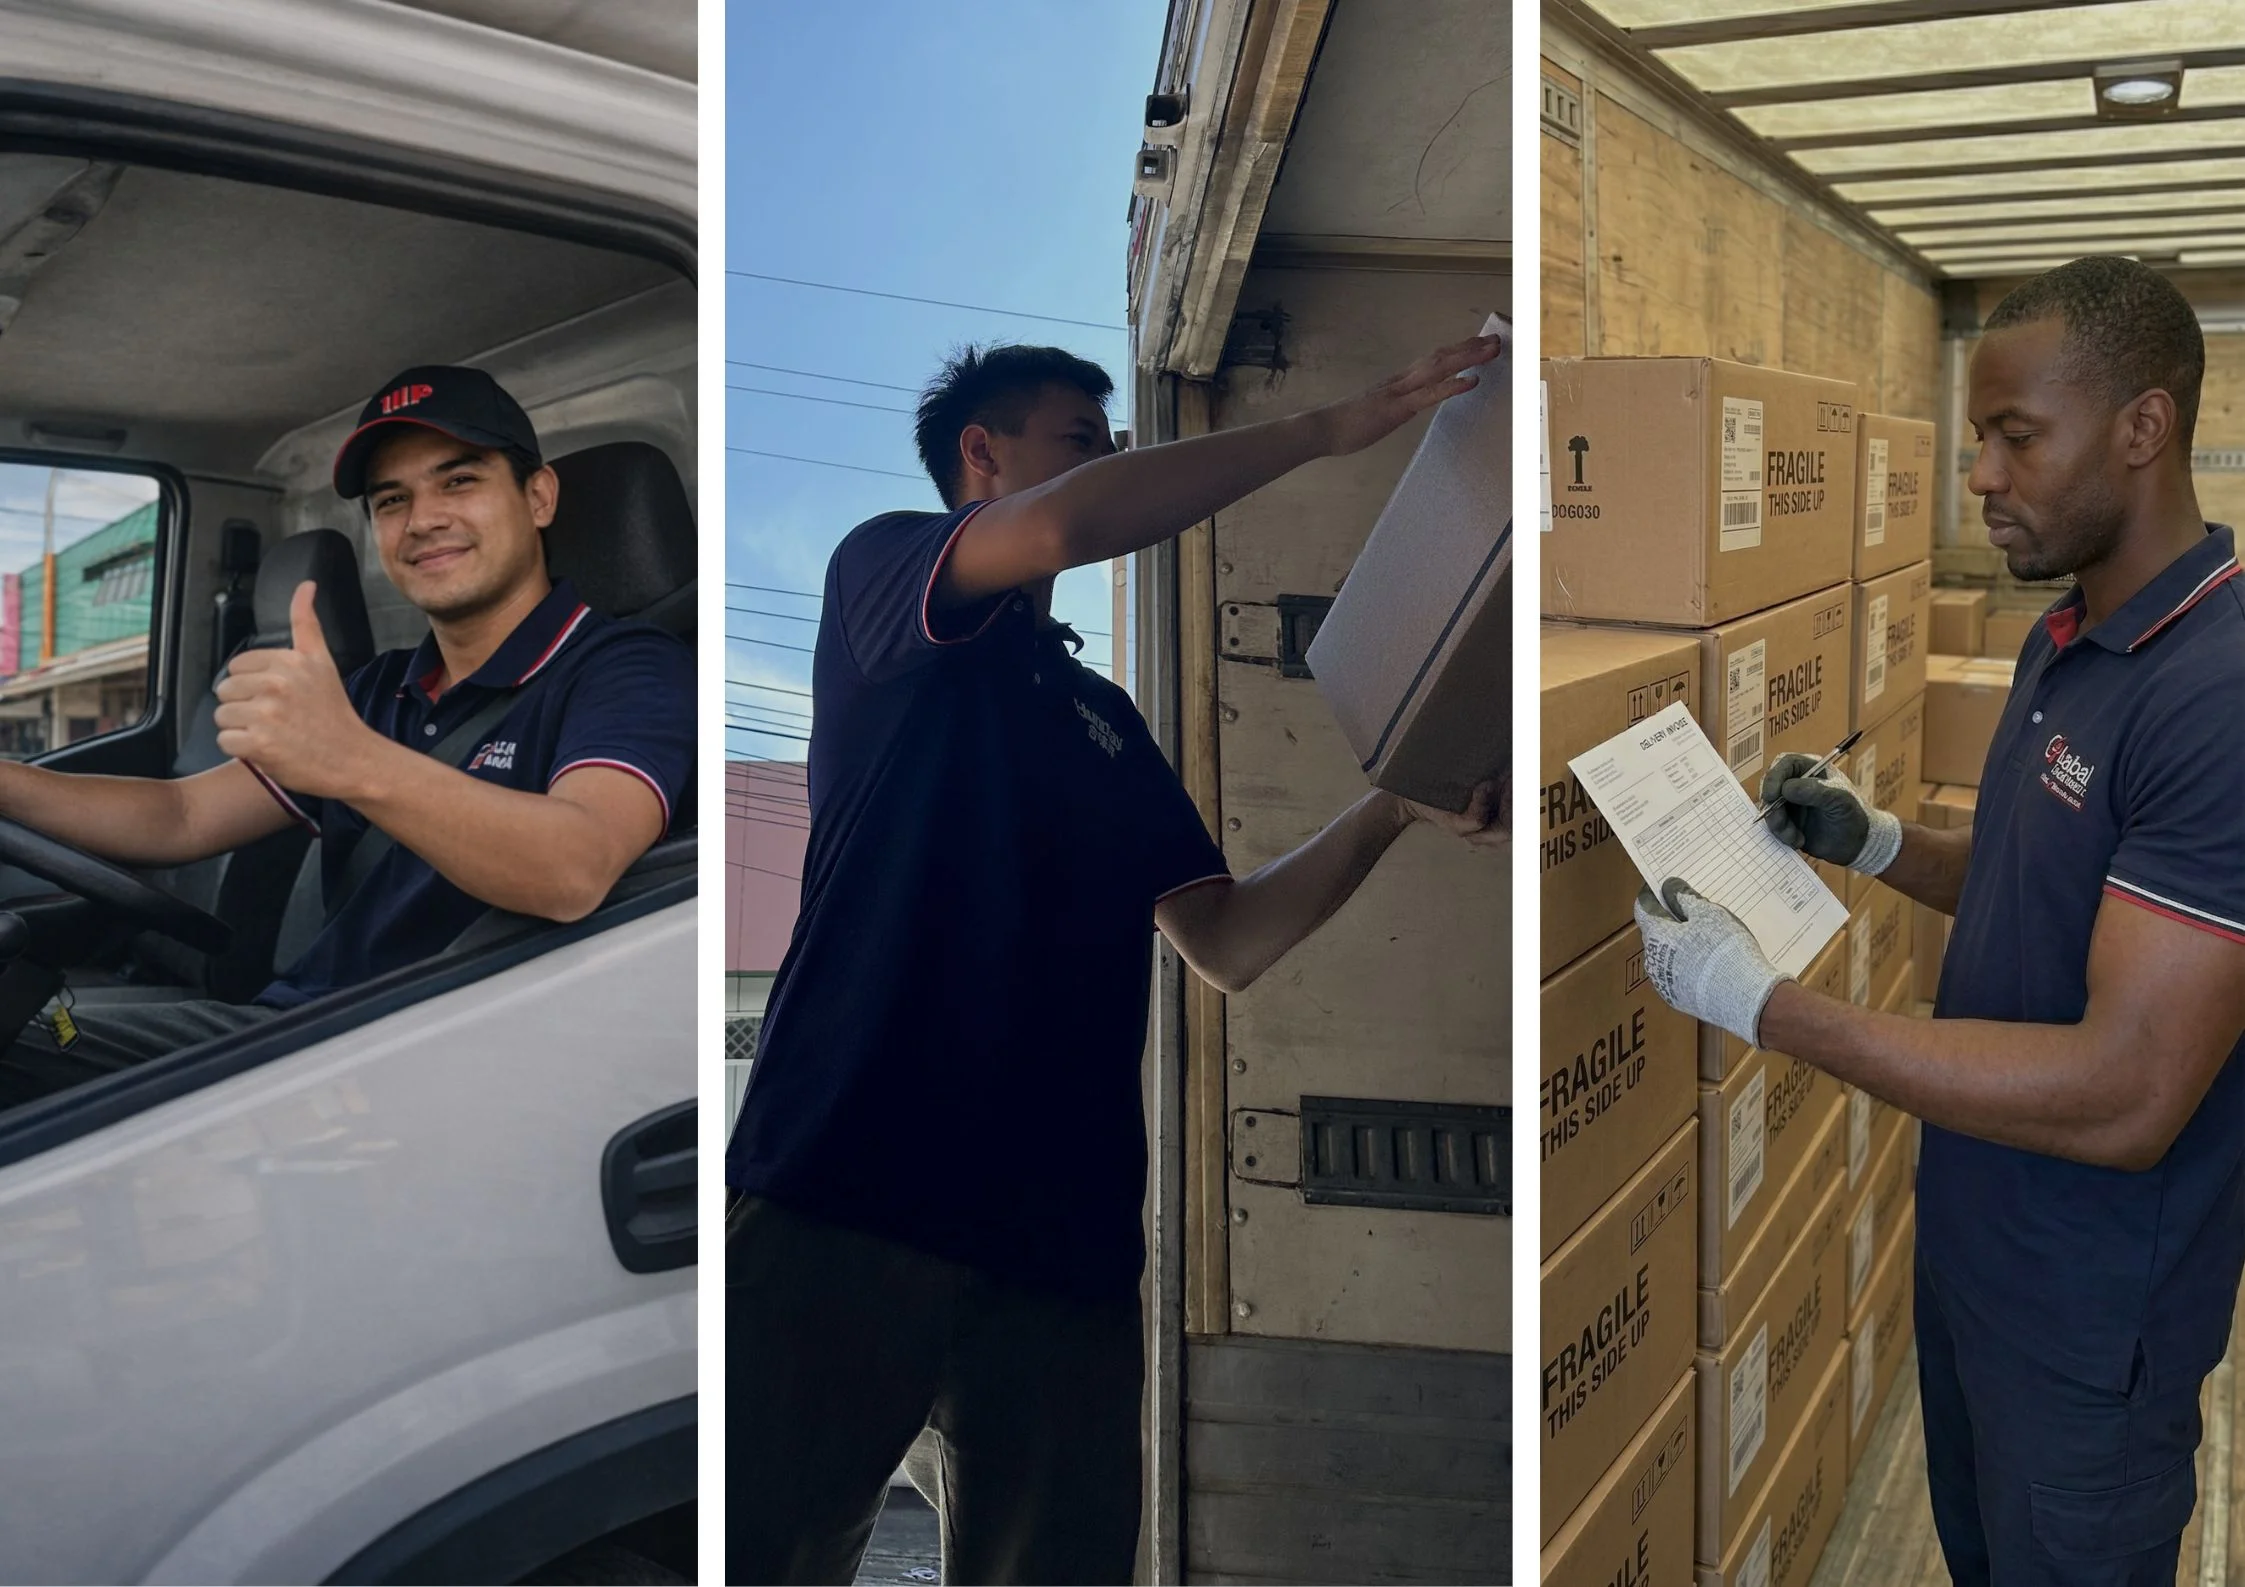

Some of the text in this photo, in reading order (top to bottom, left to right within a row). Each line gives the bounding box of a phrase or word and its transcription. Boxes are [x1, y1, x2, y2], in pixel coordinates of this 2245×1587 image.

[1767, 451, 1825, 486] FRAGILE
[1769, 489, 1825, 517] THIS SIDE UP
[1768, 654, 1822, 712] FRAGILE
[1768, 709, 1789, 738] THIS
[1791, 696, 1810, 726] SIDE
[1811, 690, 1822, 713] UP
[1582, 815, 1615, 851] SID
[1540, 1055, 1646, 1163] THIS SIDE UP
[1542, 1263, 1649, 1412] FRAGILE
[1768, 1273, 1822, 1385] FRAGILE
[1547, 1309, 1650, 1440] THIS SIDE UP
